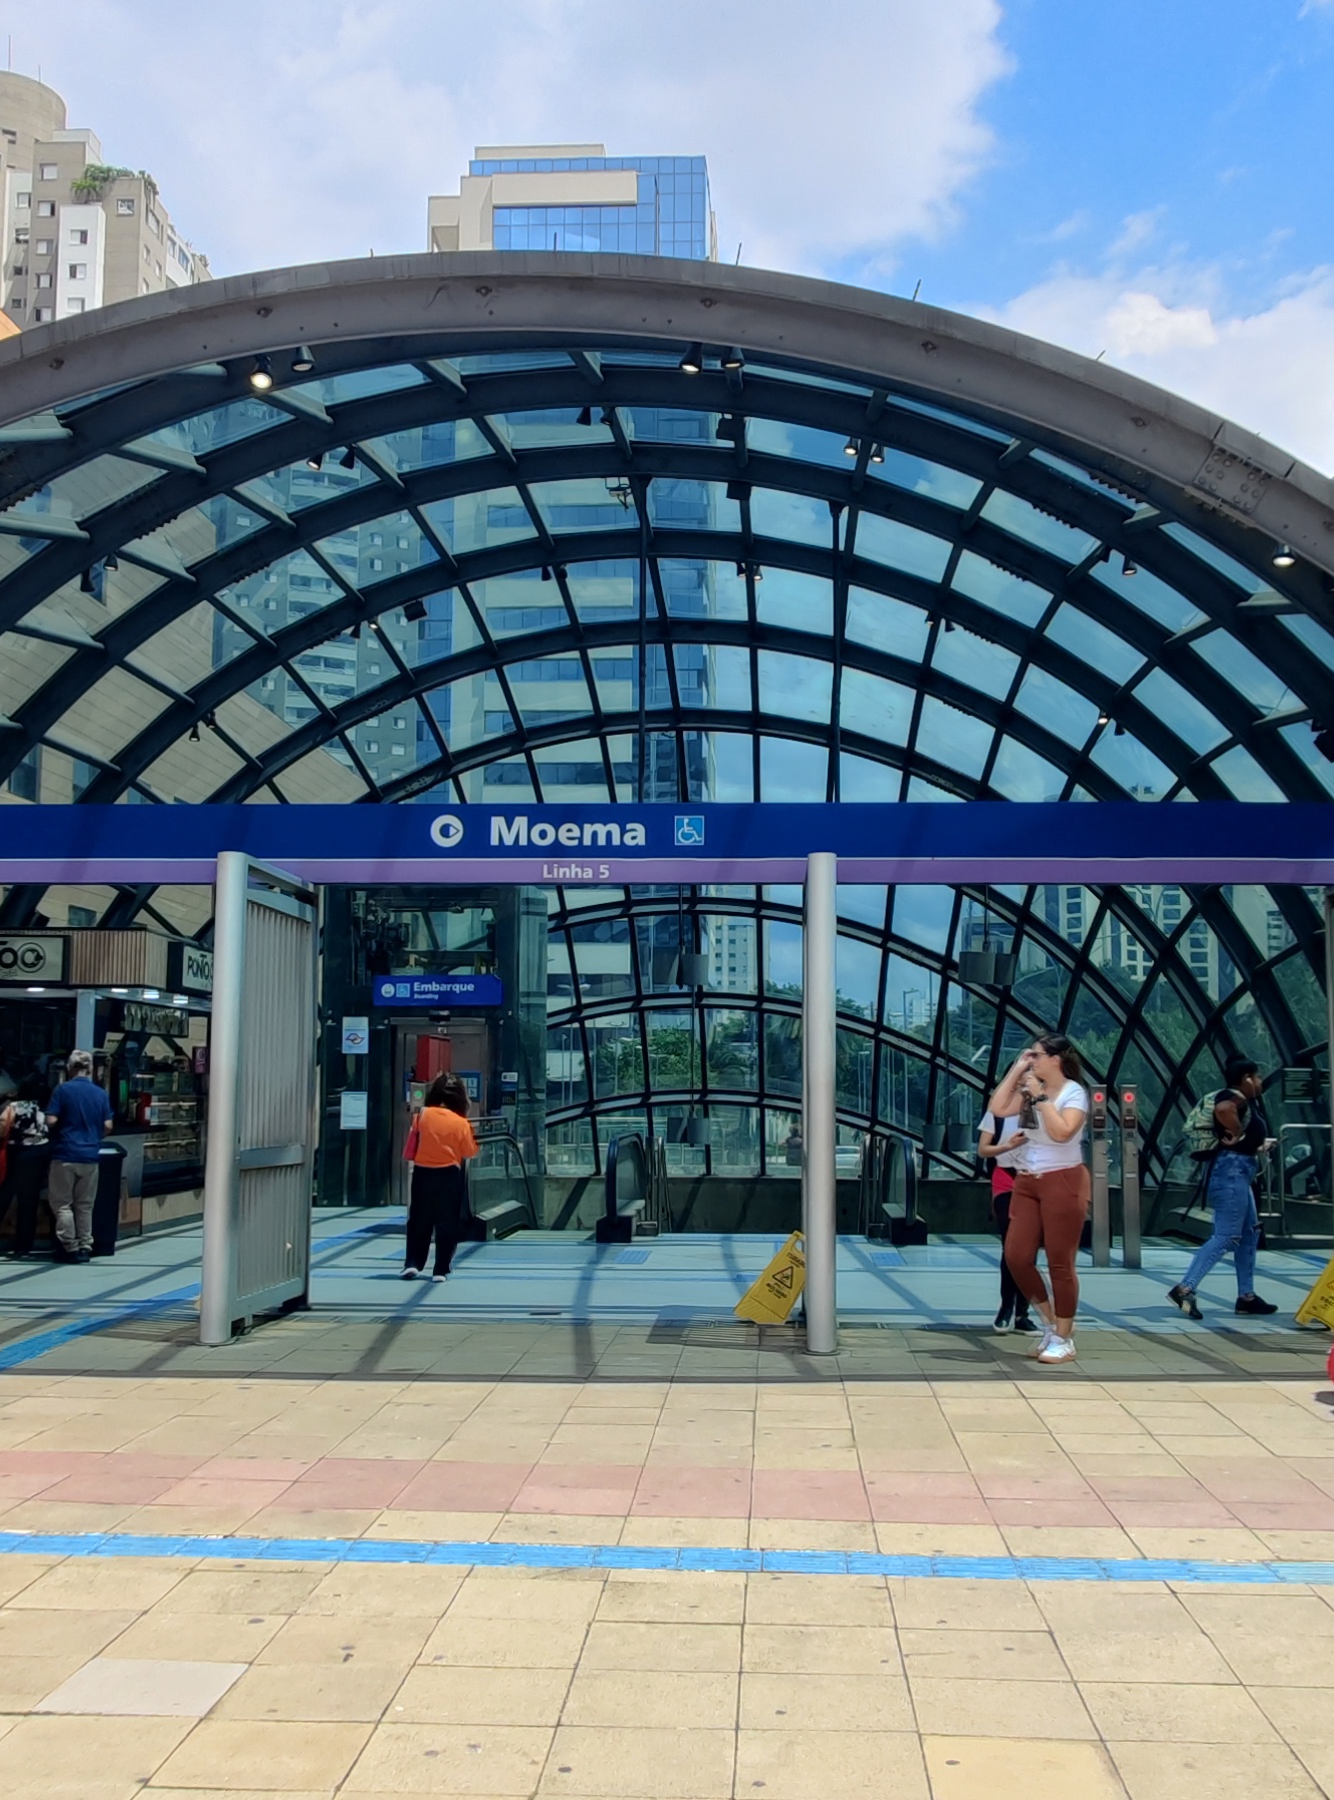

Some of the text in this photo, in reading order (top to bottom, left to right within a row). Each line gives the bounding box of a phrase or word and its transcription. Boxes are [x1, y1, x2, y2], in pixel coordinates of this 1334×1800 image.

[490, 816, 646, 846] Moema
[542, 864, 610, 879] Linha 5
[413, 980, 475, 994] Embarque
